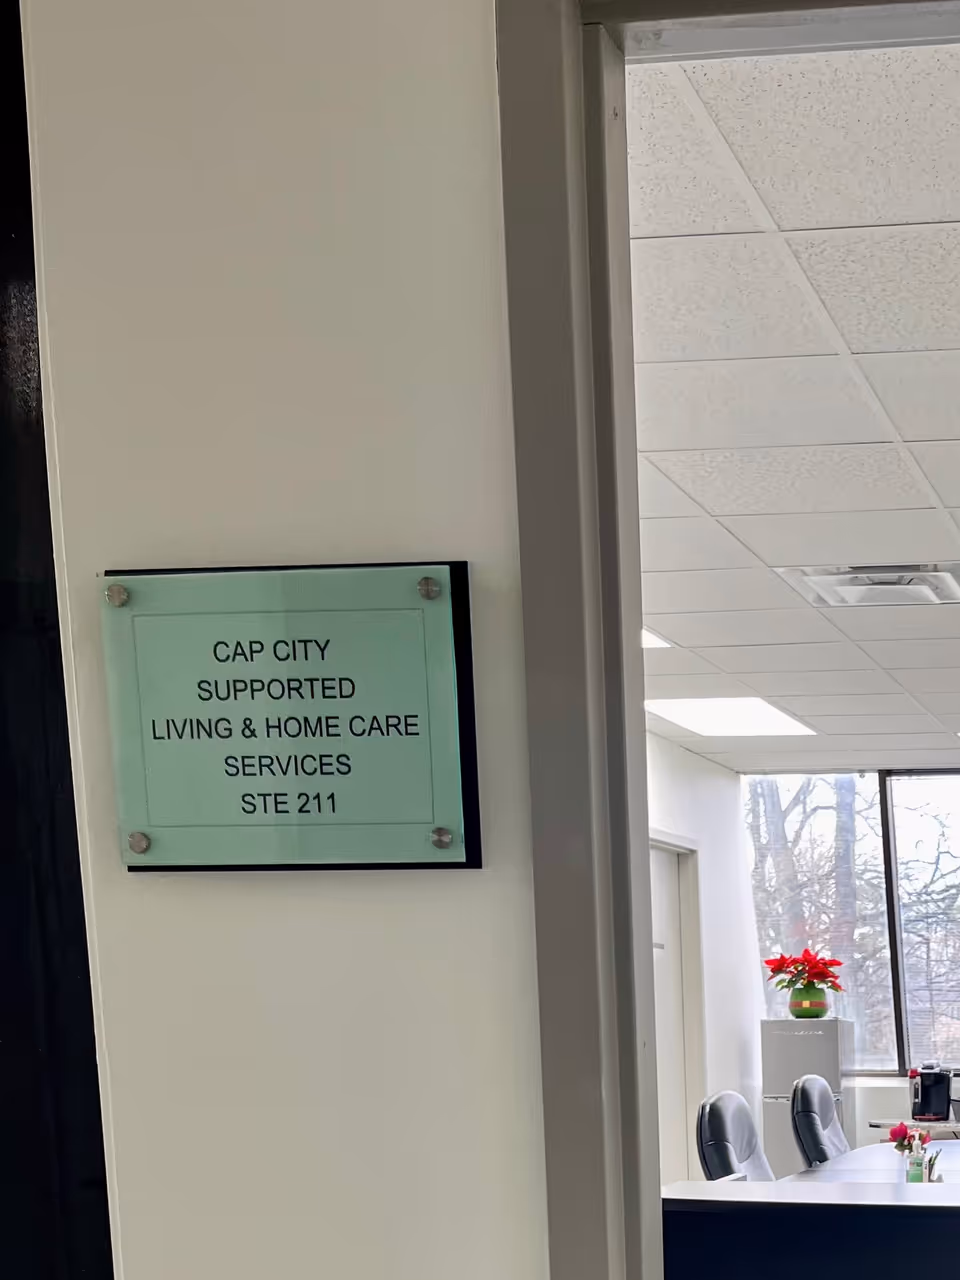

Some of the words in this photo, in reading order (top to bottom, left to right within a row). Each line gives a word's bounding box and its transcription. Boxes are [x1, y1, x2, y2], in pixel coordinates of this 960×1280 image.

[213, 640, 265, 664] CAP
[273, 639, 331, 662] CITY
[197, 678, 356, 702] SUPPORTED
[152, 718, 233, 741] LIVING
[241, 717, 258, 740] &
[266, 716, 342, 739] HOME
[349, 715, 420, 738] CARE
[224, 753, 352, 777] SERVICES
[242, 793, 290, 815] STE
[297, 792, 336, 814] 211
